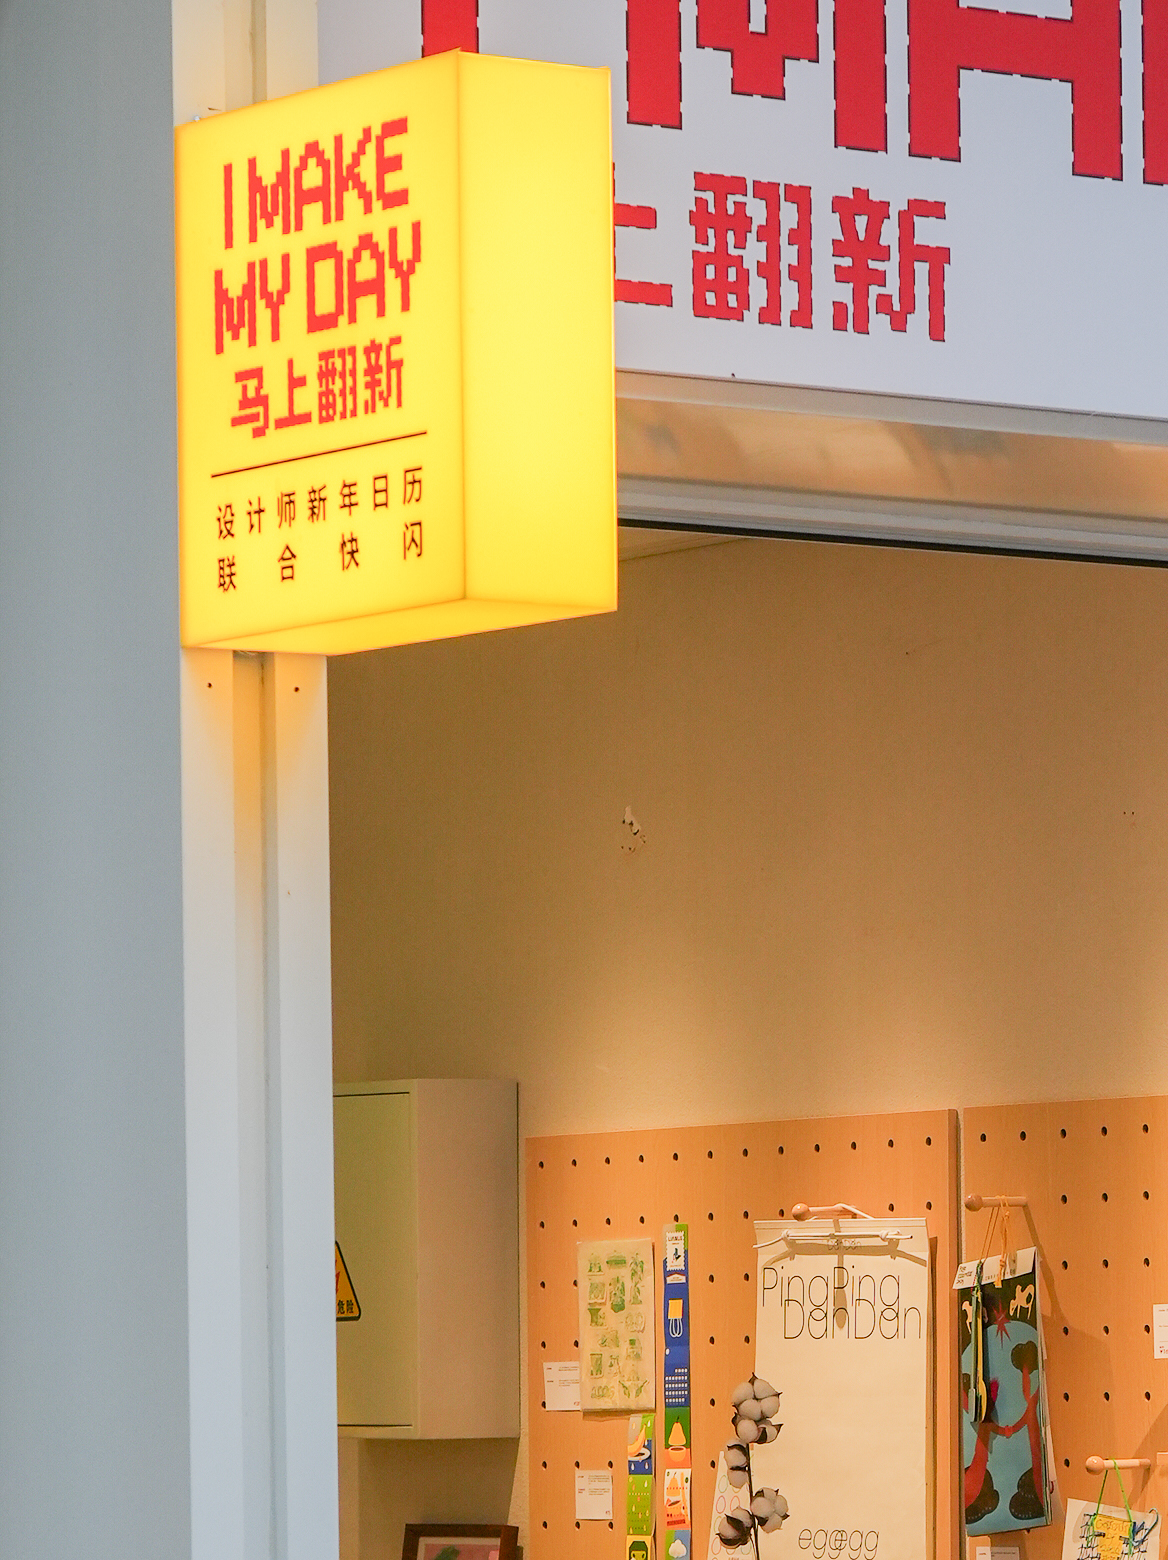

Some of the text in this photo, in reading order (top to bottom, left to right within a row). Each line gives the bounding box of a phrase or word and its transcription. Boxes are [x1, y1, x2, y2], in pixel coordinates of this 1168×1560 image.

[248, 117, 408, 243] MAKE
[214, 223, 422, 354] MY DAY
[230, 336, 404, 438] 马上翻新
[216, 466, 423, 540] 设计师新年日历
